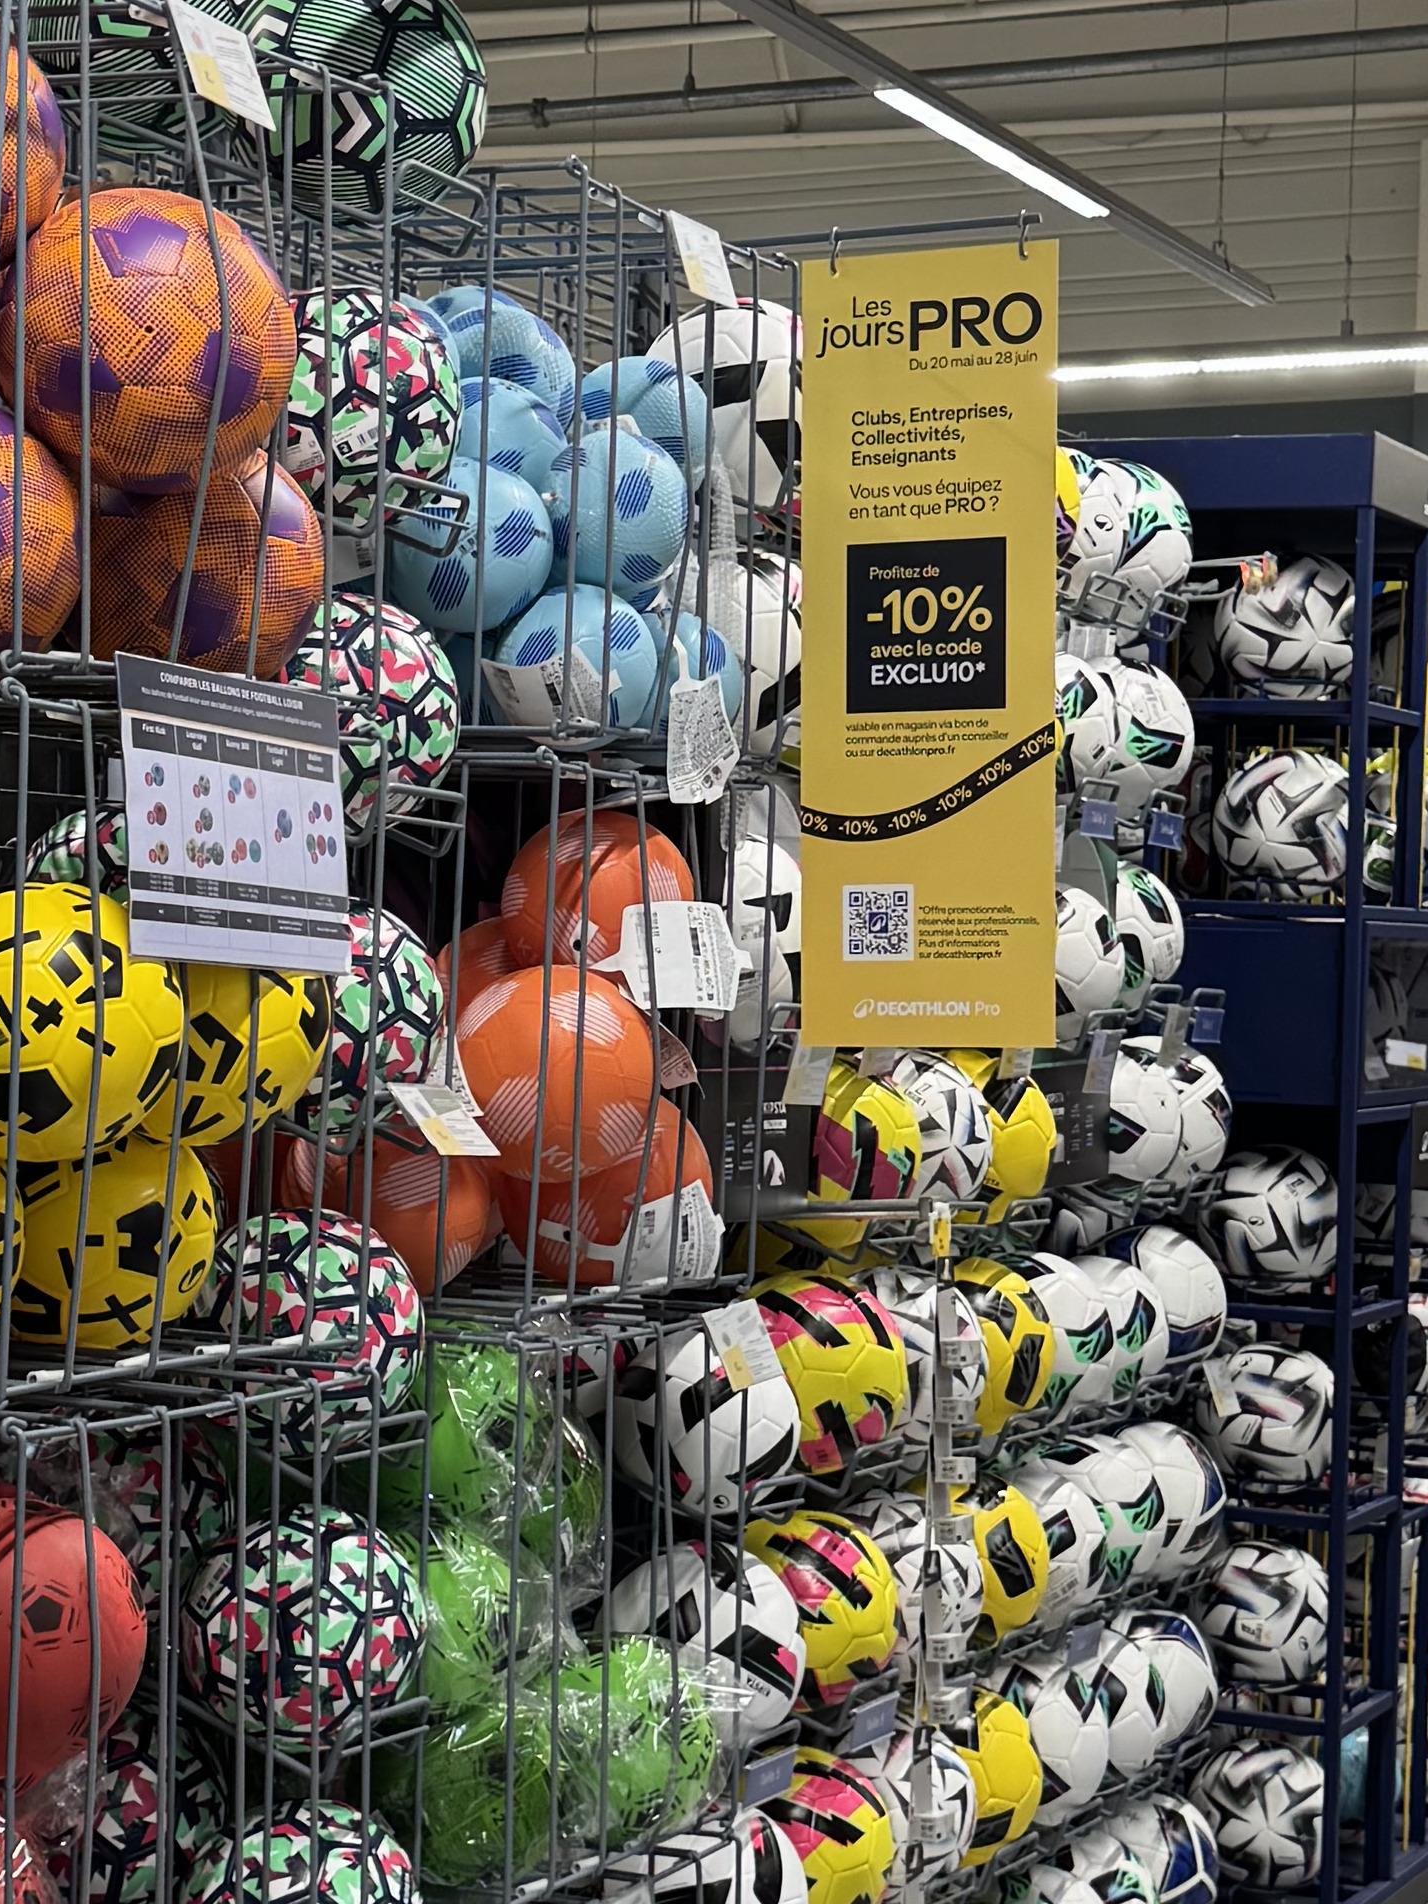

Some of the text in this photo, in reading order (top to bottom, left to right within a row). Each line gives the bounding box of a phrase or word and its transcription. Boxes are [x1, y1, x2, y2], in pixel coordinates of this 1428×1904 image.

[852, 296, 892, 319] Les
[815, 292, 1043, 359] jours PRO
[909, 350, 1038, 370] Du 20 mai au 28 juin
[852, 403, 1013, 426] Clubs, Entreprises,
[852, 425, 965, 446] Collectivités,
[852, 447, 957, 467] Enseignants
[849, 477, 1002, 499] Vous vous équipez
[849, 496, 999, 519] en tant que PRO ?
[869, 564, 940, 580] Profitez de
[866, 585, 993, 635] -10%
[870, 637, 982, 658] avec le code
[895, 720, 937, 732] magasin
[845, 733, 901, 745] commande
[838, 818, 878, 835] -10%
[887, 808, 927, 830] -10%
[935, 784, 972, 813] -10%
[976, 758, 1012, 788] -10%
[1018, 730, 1055, 760] -10%
[876, 1000, 1001, 1017] DECATHLON Pro
